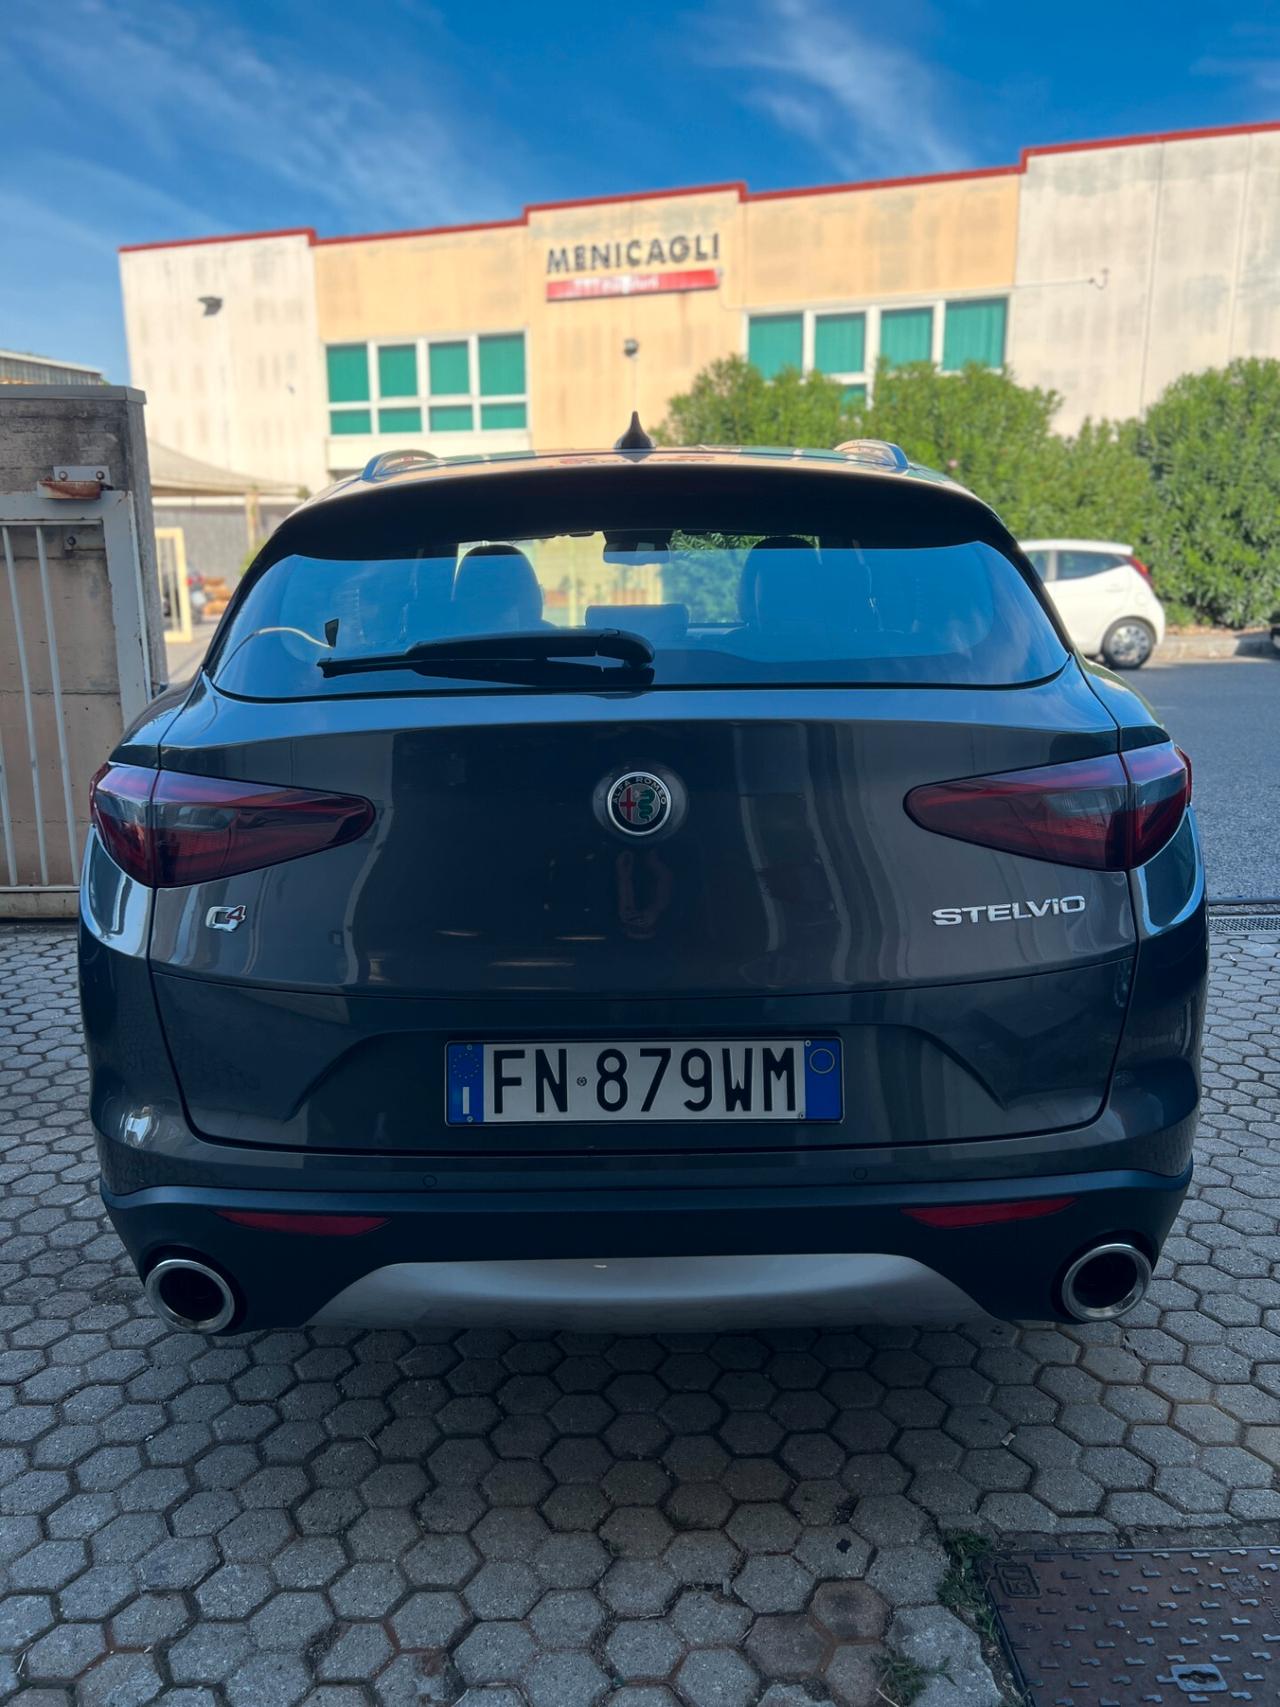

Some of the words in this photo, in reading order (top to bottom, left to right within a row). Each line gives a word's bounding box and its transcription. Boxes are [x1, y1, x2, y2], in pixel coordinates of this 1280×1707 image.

[546, 233, 720, 274] MENICAGLI
[612, 780, 632, 804] ALFA
[635, 776, 667, 805] ROMEO
[205, 904, 246, 932] Q4
[932, 895, 1086, 926] STELVIO
